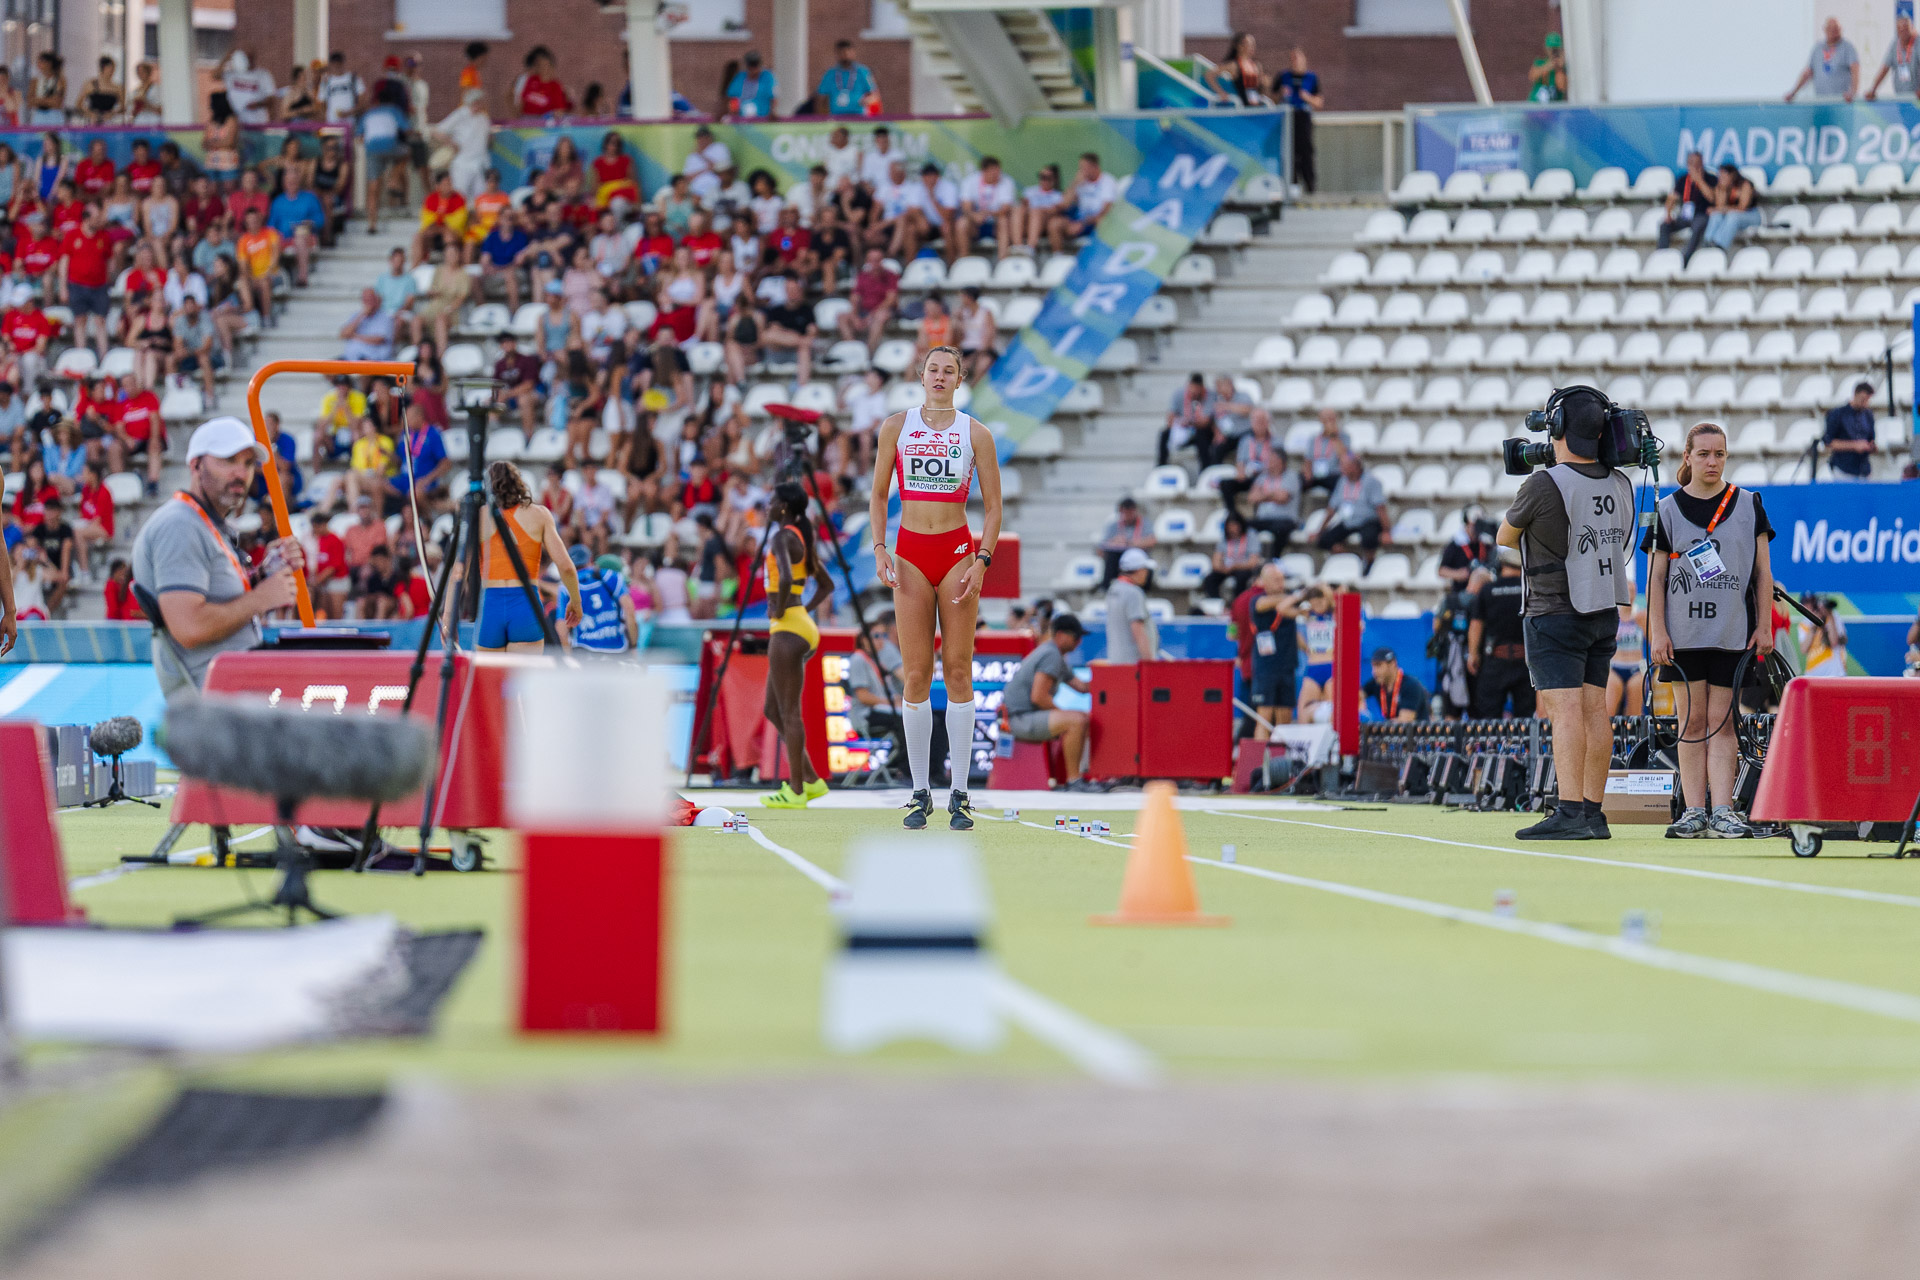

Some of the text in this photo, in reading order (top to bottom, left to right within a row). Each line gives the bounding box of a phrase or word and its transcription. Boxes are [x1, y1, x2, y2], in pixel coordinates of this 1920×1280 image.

[1676, 124, 1849, 166] MADRID
[1004, 152, 1229, 399] MADRID
[905, 445, 947, 457] SPAR
[911, 457, 956, 477] POL
[909, 482, 957, 491] MADRID 2025
[1592, 494, 1615, 516] 30
[1791, 515, 1920, 564] Madrid
[1694, 581, 1740, 591] ATHLETICS
[1688, 601, 1717, 619] HB
